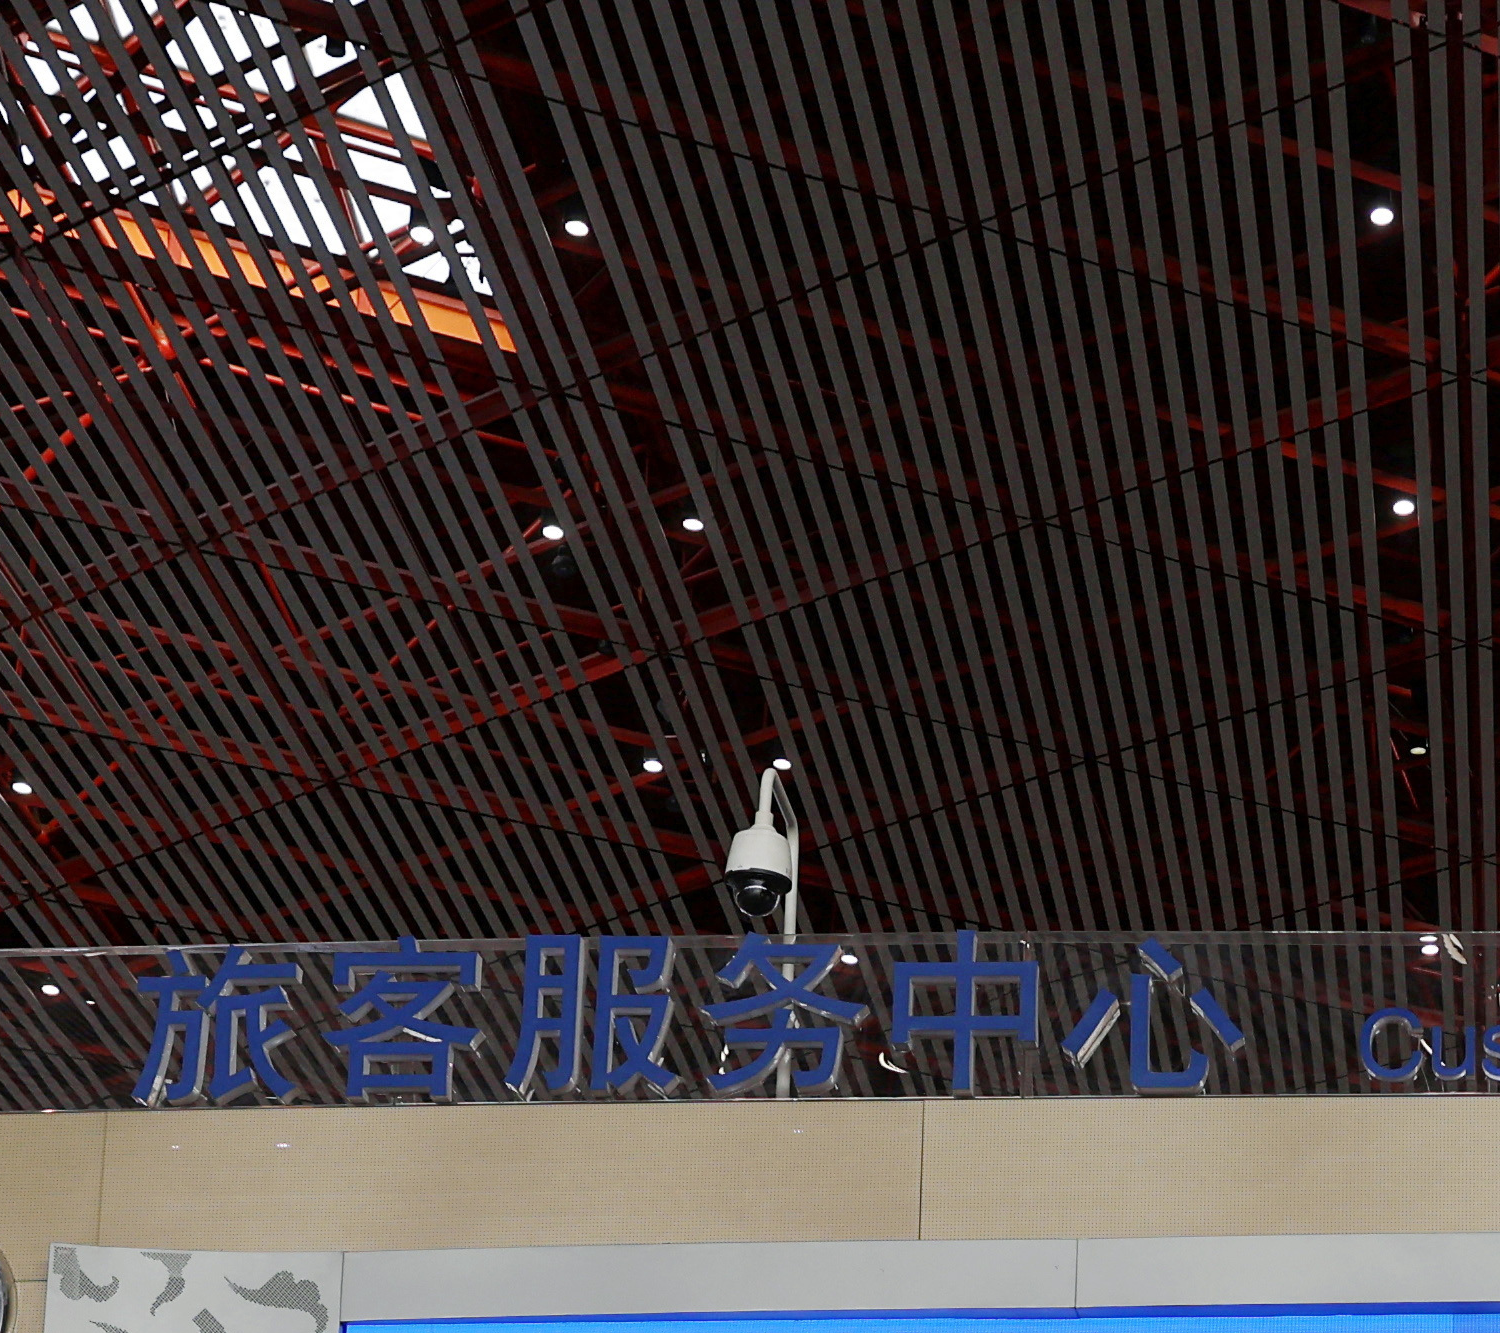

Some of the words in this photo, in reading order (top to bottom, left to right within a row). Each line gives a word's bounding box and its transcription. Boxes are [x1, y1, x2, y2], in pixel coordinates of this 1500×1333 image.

[132, 930, 1245, 1108] 旅客服务中心
